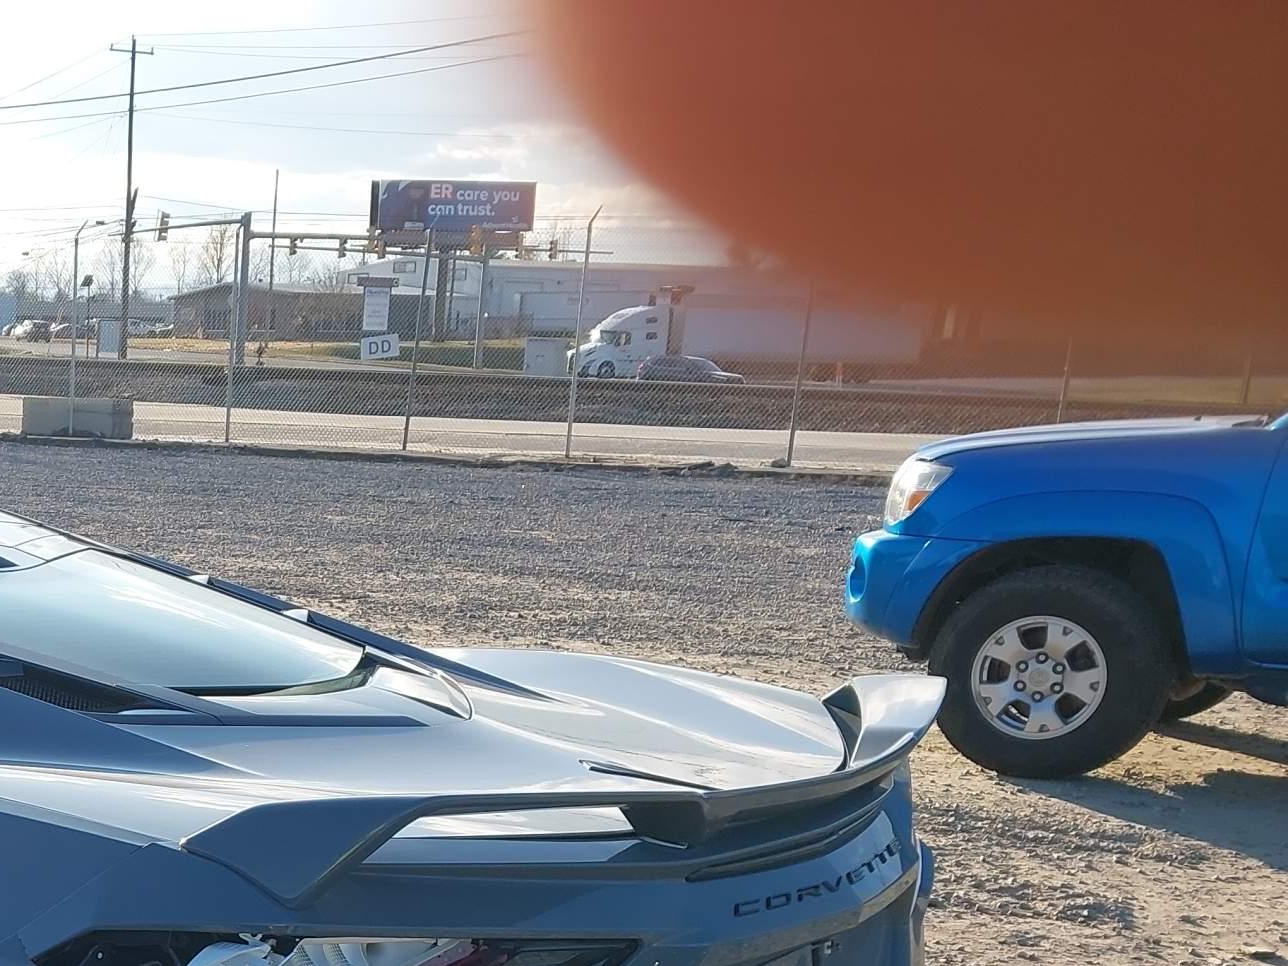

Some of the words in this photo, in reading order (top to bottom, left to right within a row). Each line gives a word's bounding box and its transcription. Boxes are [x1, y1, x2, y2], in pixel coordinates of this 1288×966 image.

[430, 184, 453, 199] ER
[456, 190, 488, 202] care
[492, 190, 520, 204] you
[428, 204, 455, 216] can
[457, 203, 495, 217] trust.
[733, 839, 902, 917] CORVETTE
